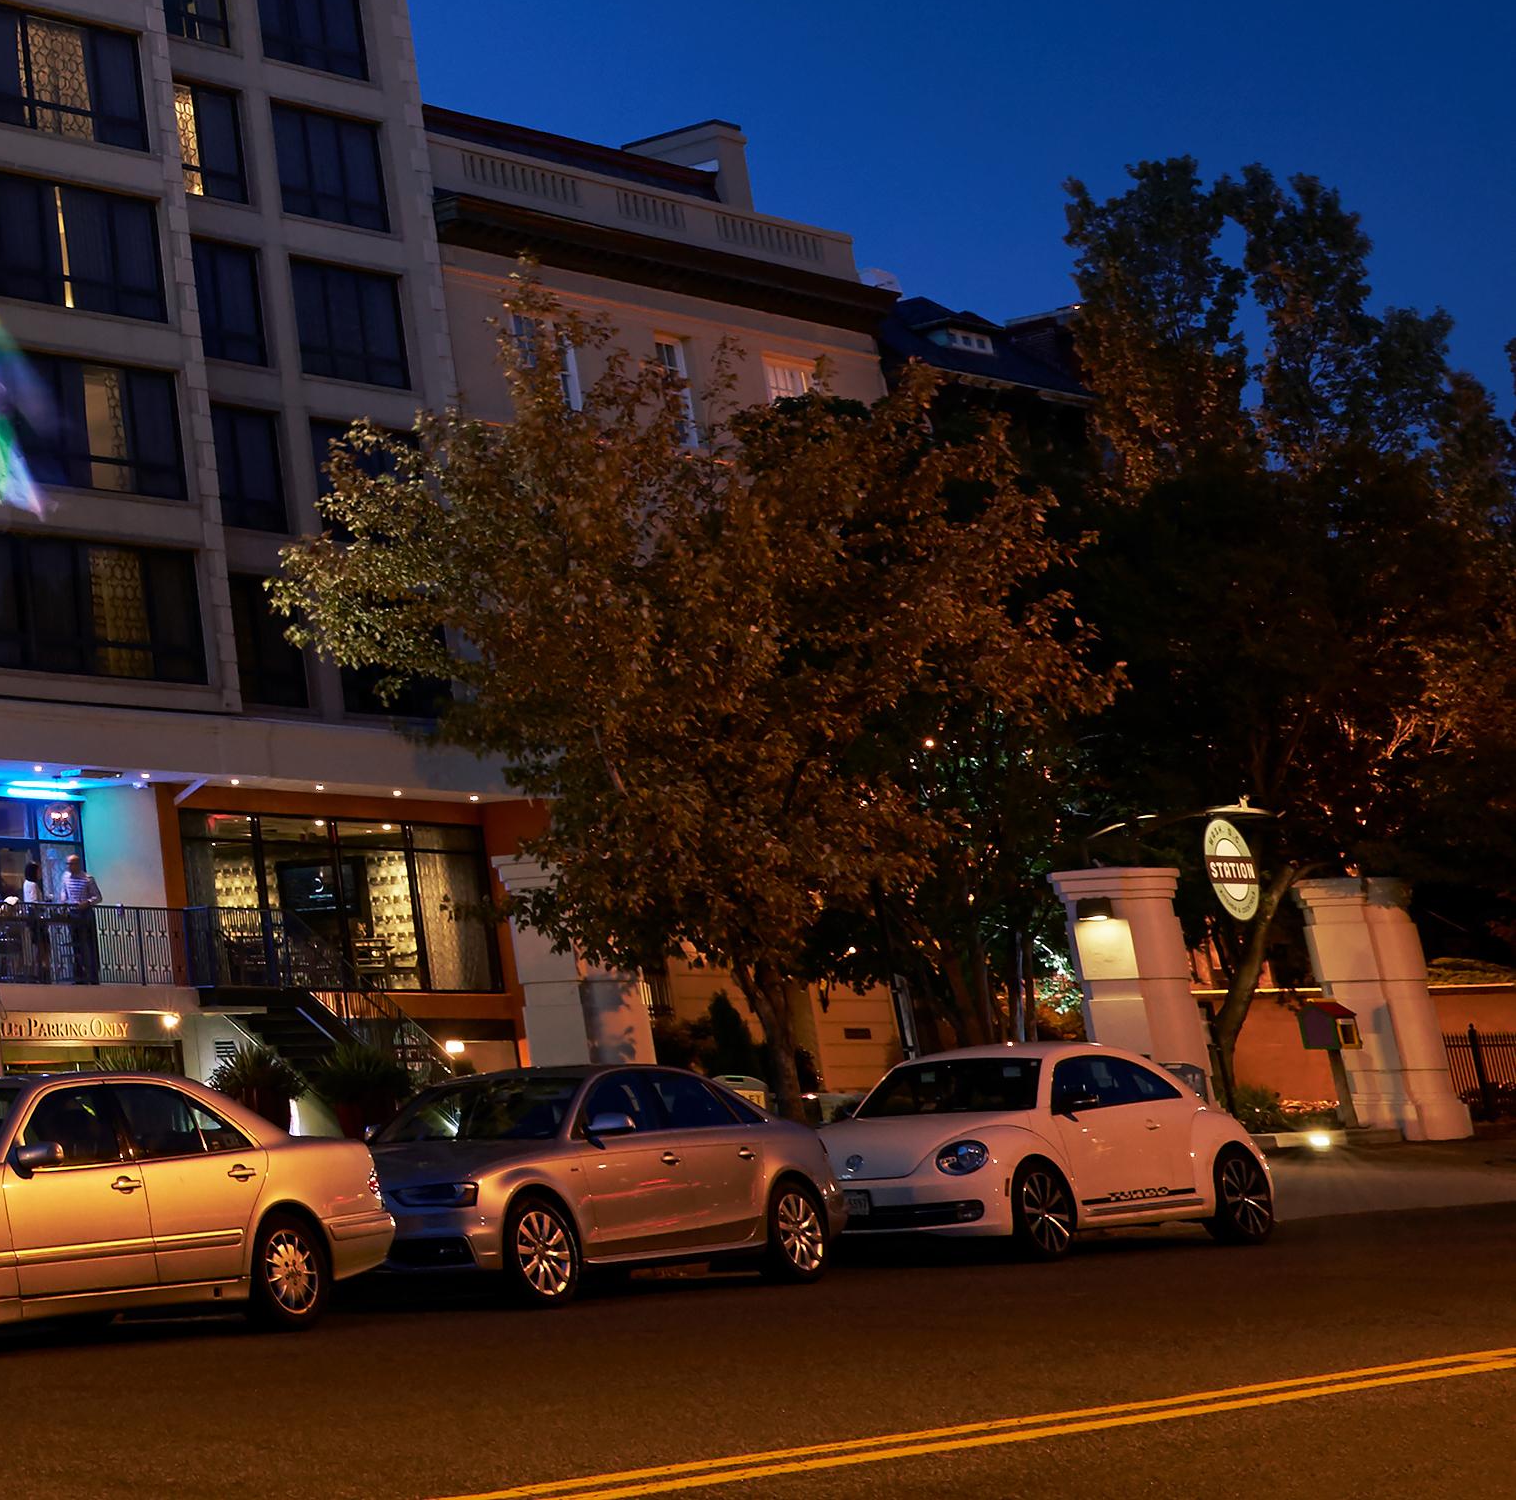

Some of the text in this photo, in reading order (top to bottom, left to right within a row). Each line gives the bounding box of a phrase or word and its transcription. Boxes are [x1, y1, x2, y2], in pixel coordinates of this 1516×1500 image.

[1209, 861, 1256, 879] STATION
[28, 1018, 87, 1038] PARKING
[91, 1018, 129, 1038] ONLY
[1108, 1186, 1169, 1201] TURBO
